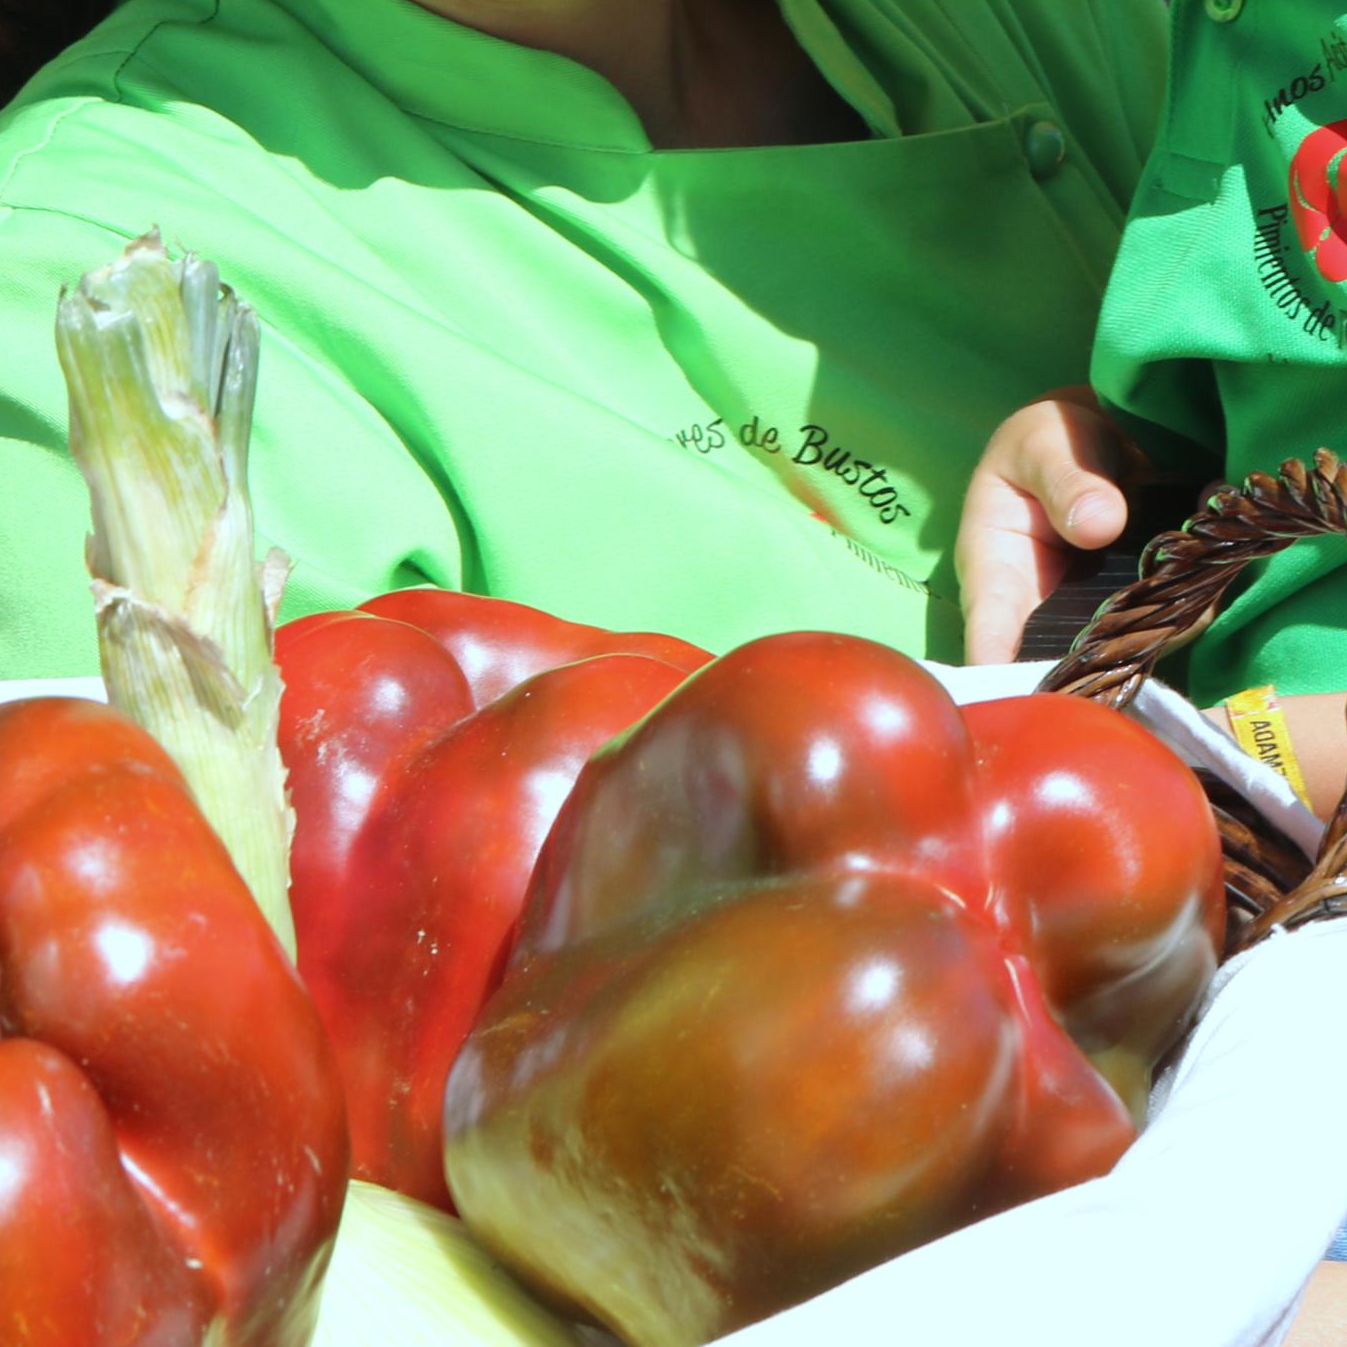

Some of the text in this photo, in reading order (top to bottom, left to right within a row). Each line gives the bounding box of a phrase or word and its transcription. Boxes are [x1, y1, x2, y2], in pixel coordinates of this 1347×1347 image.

[1253, 203, 1309, 321] Pimientos
[1302, 300, 1336, 342] de
[739, 416, 781, 453] de
[791, 424, 911, 525] Bustos
